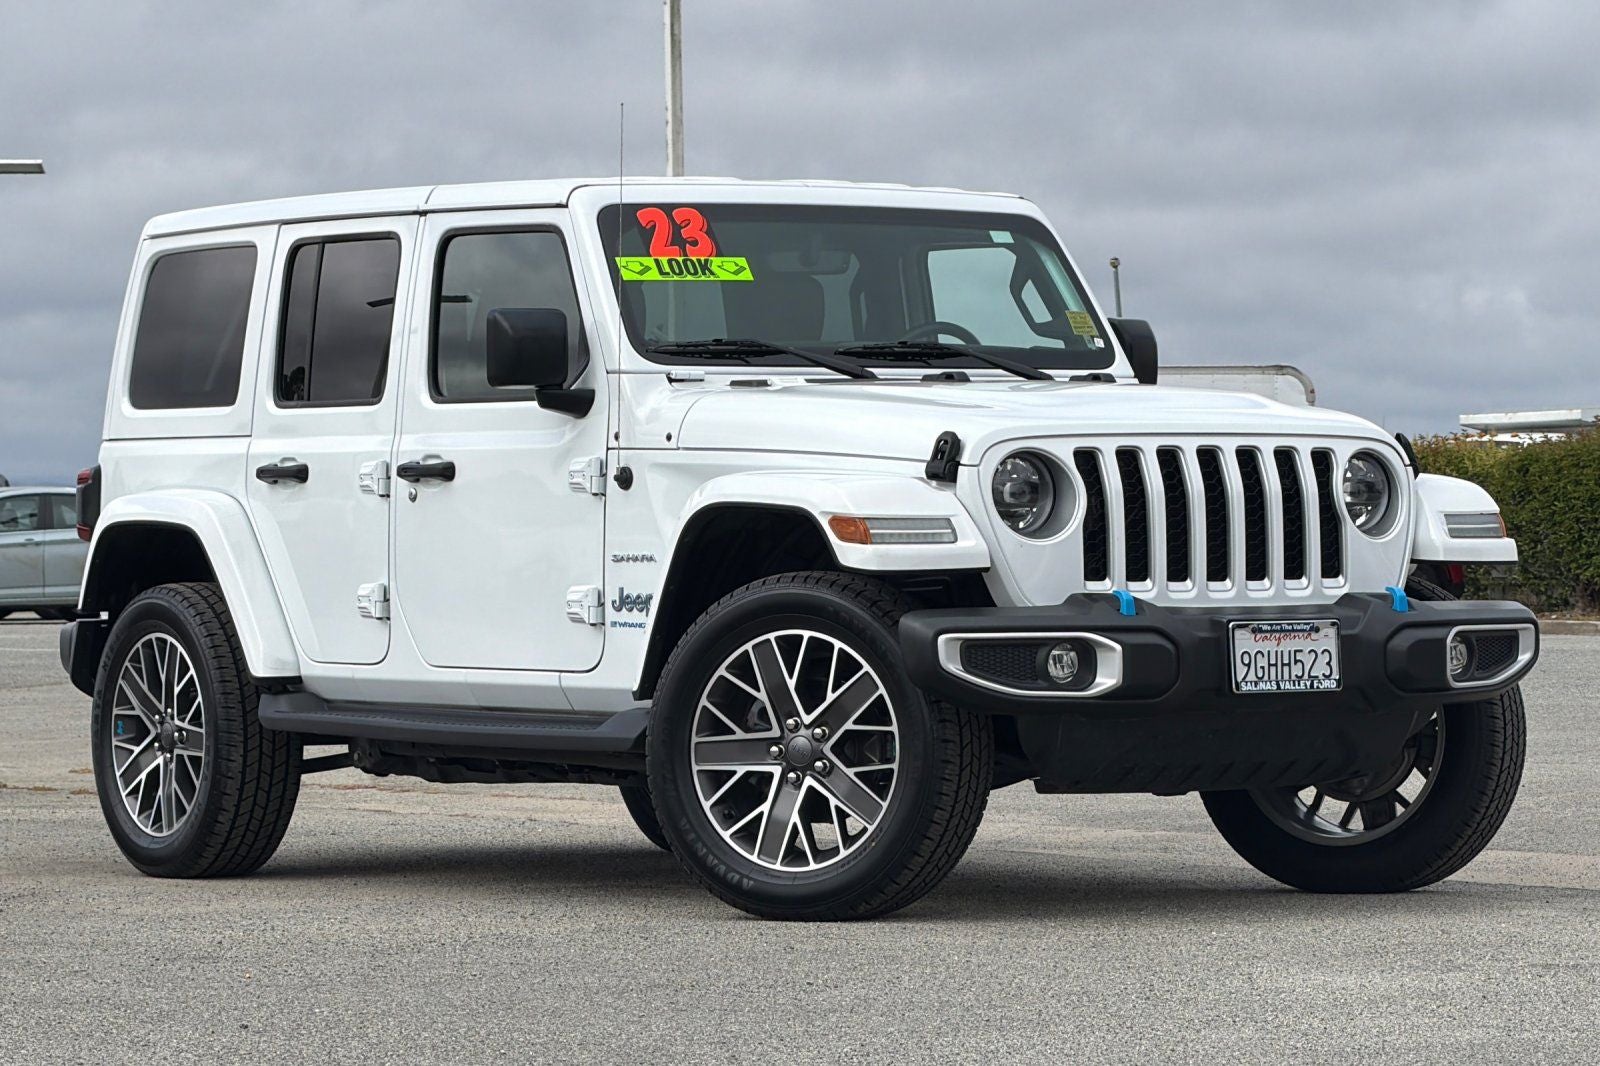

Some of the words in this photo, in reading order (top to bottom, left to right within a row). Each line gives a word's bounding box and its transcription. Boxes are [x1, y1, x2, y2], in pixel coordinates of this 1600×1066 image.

[636, 207, 717, 257] 23
[654, 257, 719, 278] LOOK
[611, 554, 657, 563] SAHARA
[611, 586, 654, 618] Jeep
[1254, 632, 1319, 646] California
[1240, 648, 1333, 681] 9GHH523
[1241, 680, 1277, 691] SALINAS
[1279, 680, 1311, 690] VALLEY
[1313, 679, 1337, 689] FORD
